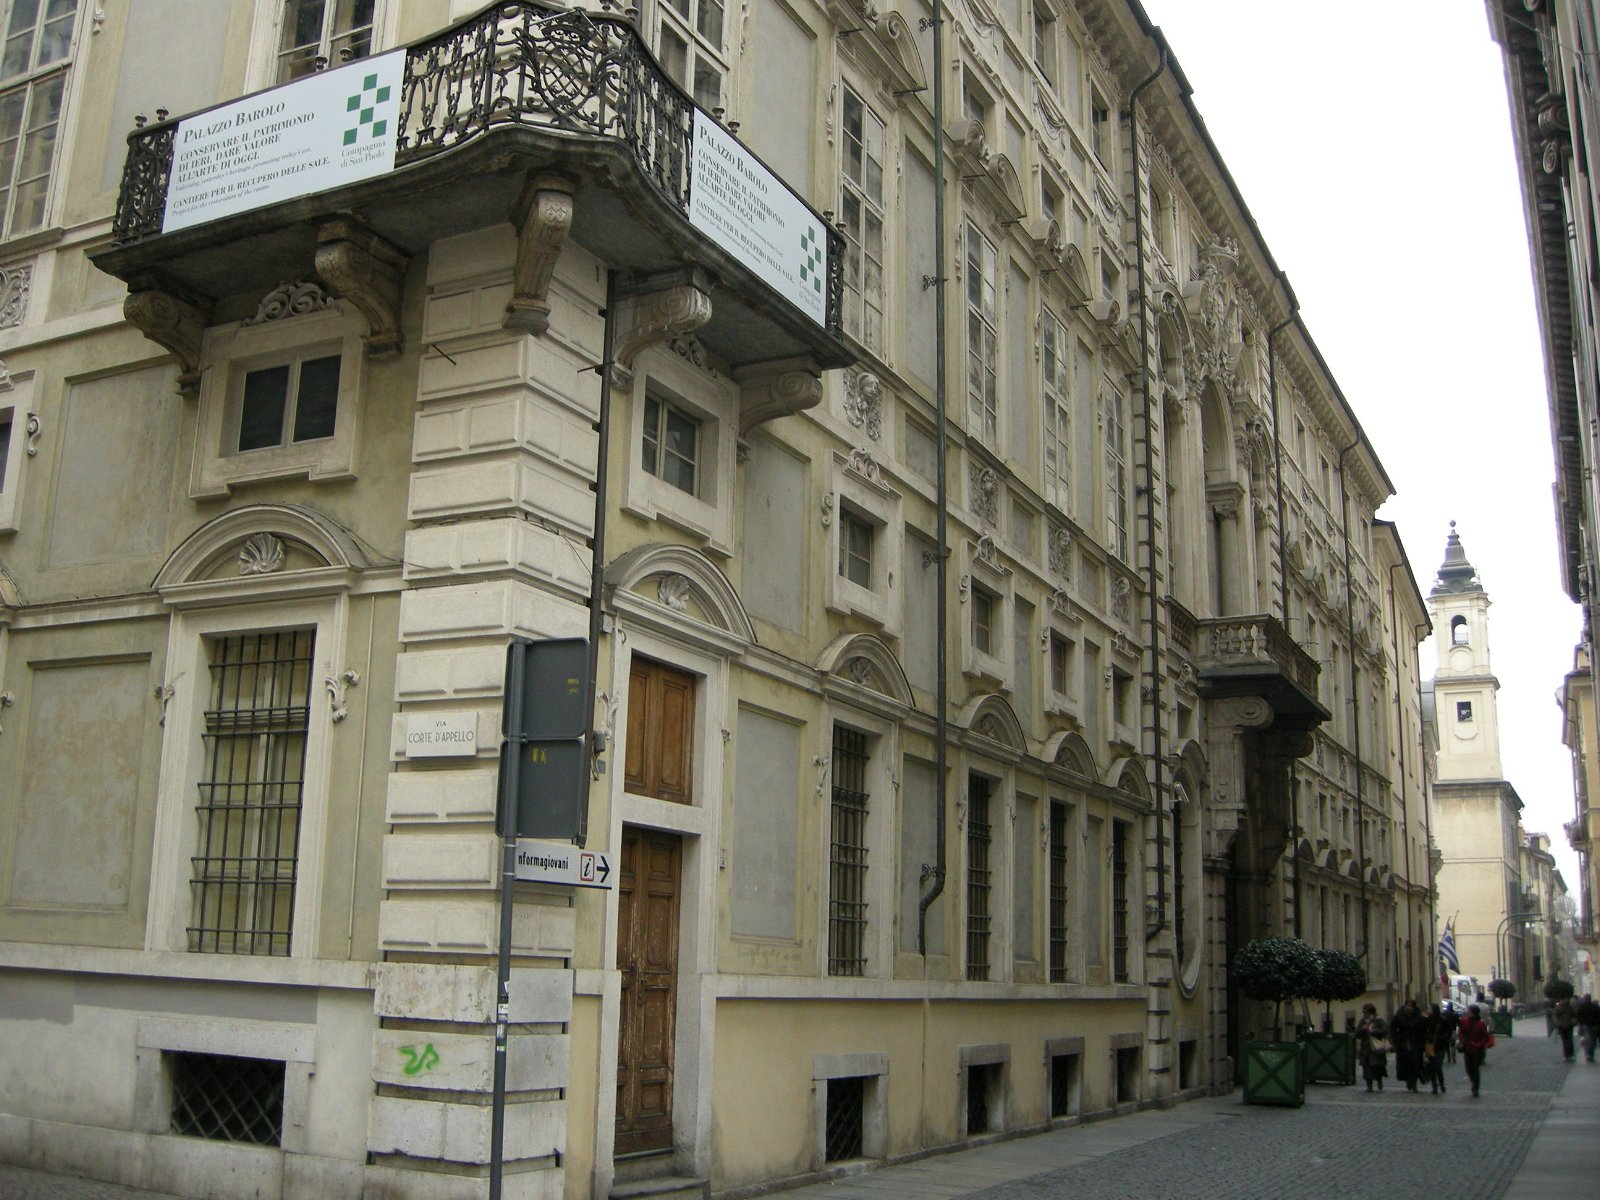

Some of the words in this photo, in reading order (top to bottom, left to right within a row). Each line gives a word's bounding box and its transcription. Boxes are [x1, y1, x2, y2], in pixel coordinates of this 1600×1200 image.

[178, 161, 188, 172] DI
[215, 145, 241, 160] DARE
[243, 132, 281, 151] VALORE
[180, 136, 239, 161] CONSERVARE
[241, 131, 251, 141] IL
[253, 111, 314, 137] PATRIMONIO
[220, 159, 230, 170] DI
[698, 146, 740, 190] CONSERVARE
[173, 191, 208, 208] CANTIERE
[210, 186, 226, 197] PER
[227, 183, 236, 192] IL
[236, 170, 279, 189] RECUPERO
[280, 162, 306, 177] DELLE
[409, 732, 432, 743] CORTE
[436, 731, 474, 742] D'APPELLO
[518, 852, 568, 870] nformagiovani
